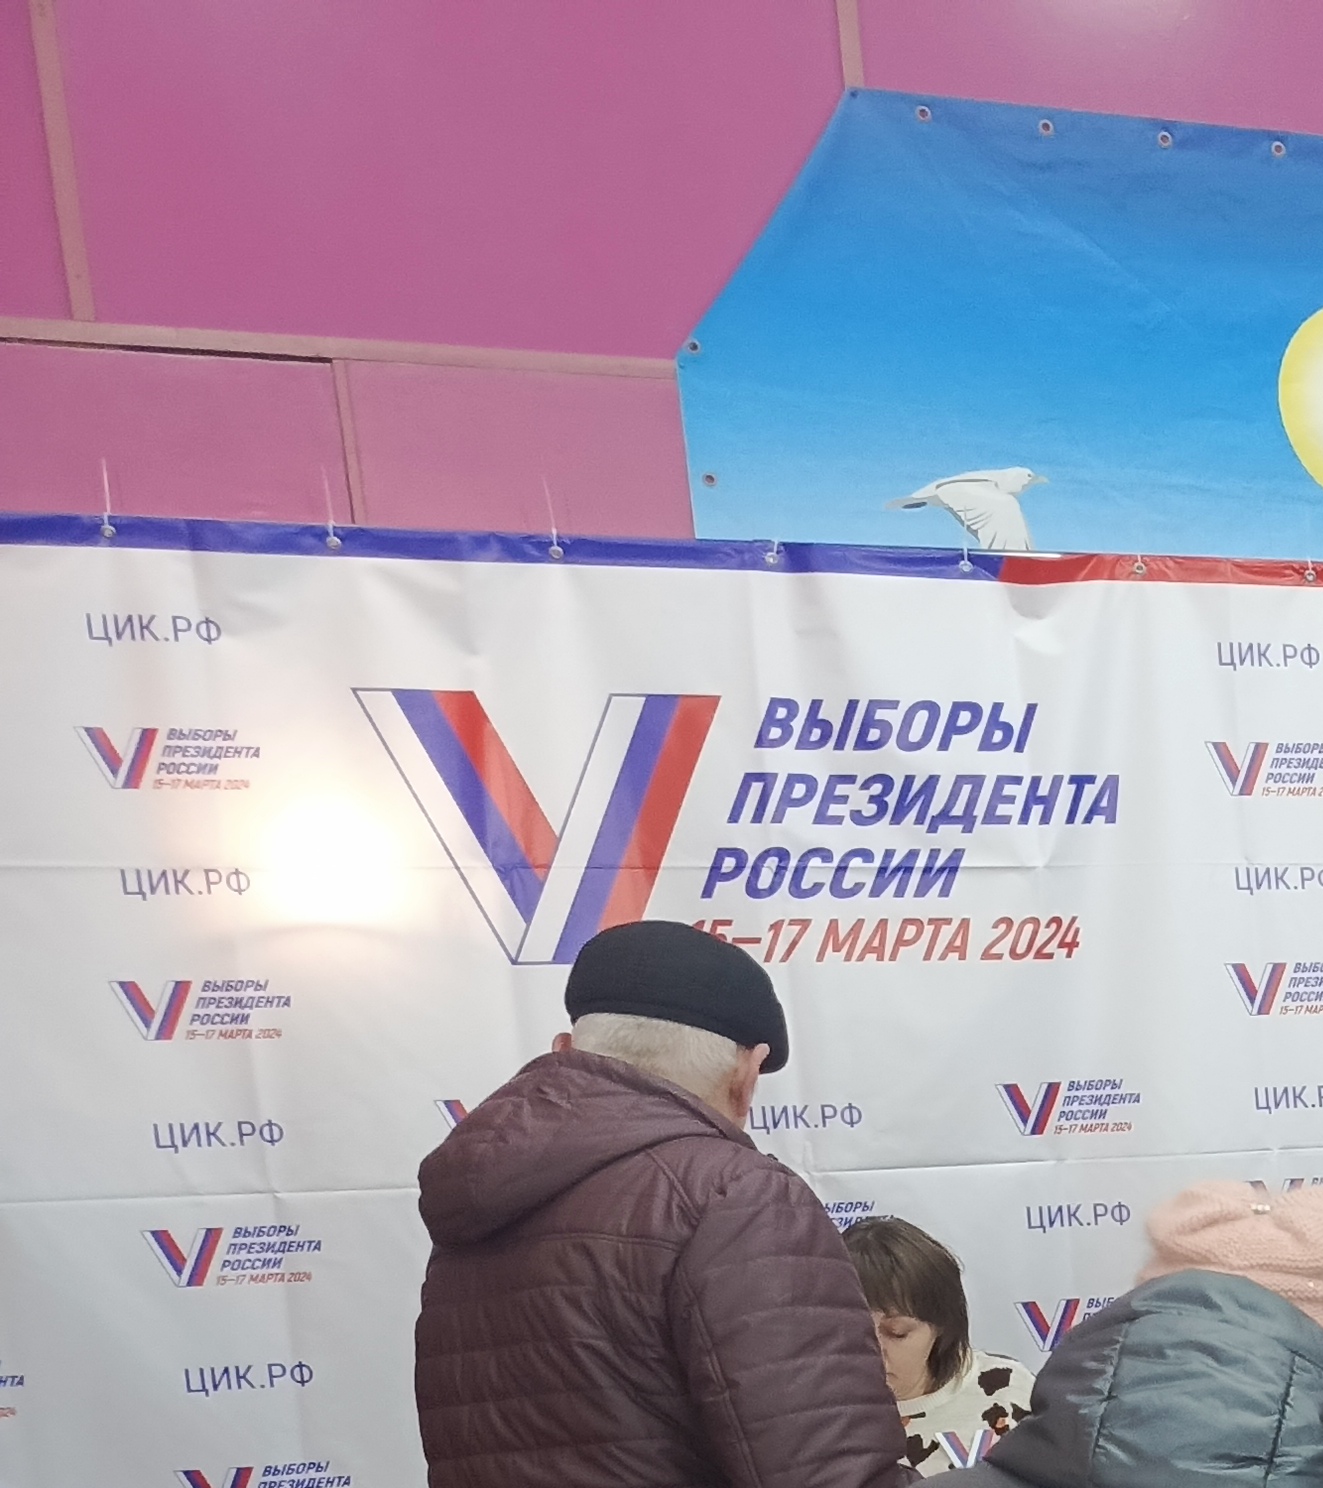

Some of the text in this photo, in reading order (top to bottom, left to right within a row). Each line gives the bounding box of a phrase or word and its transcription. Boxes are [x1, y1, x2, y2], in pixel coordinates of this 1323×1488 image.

[85, 612, 222, 647] ЦИК.РФ
[1216, 641, 1321, 672] ЦИК.РФ
[754, 696, 1039, 753] ВЫБОРЫ
[166, 727, 238, 742] ВЫБОРЫ
[161, 745, 261, 761] ПРЕЗИДЕНТА
[156, 762, 219, 776] РОССИИ
[1264, 771, 1316, 785] РОССИИ
[1287, 786, 1317, 798] МАРТА
[726, 771, 1120, 834] ПРЕЗИДЕНТА
[700, 846, 966, 900] РОССИИ
[119, 868, 251, 901] ЦИК.РФ
[691, 915, 1081, 963] 5–17 МАРТА 2024
[201, 979, 269, 993] ВЫБОРЫ
[195, 995, 292, 1011] ПРЕЗИДЕНТА
[189, 1013, 250, 1026] РОССИИ
[217, 1028, 254, 1040] МАРТА
[1066, 1078, 1123, 1092] ВЫБОРЫ
[1062, 1092, 1142, 1108] ПРЕЗИДЕНТА
[749, 1102, 863, 1135] ЦИК.РФ
[1057, 1107, 1108, 1122] РОССИИ
[152, 1119, 284, 1154] ЦИК.РФ
[1079, 1122, 1110, 1135] МАРТА
[824, 1200, 876, 1214] ЫБОРЫ
[1026, 1200, 1132, 1234] ЦИК.РФ
[232, 1224, 300, 1239] ВЫБОРЫ
[226, 1239, 322, 1257] ПРЕЗИДЕНТА
[220, 1257, 283, 1272] РОССИИ
[248, 1272, 286, 1286] МАРТА
[184, 1360, 314, 1397] ЦИК.РФ
[262, 1461, 331, 1478] ВЫБОРЫ
